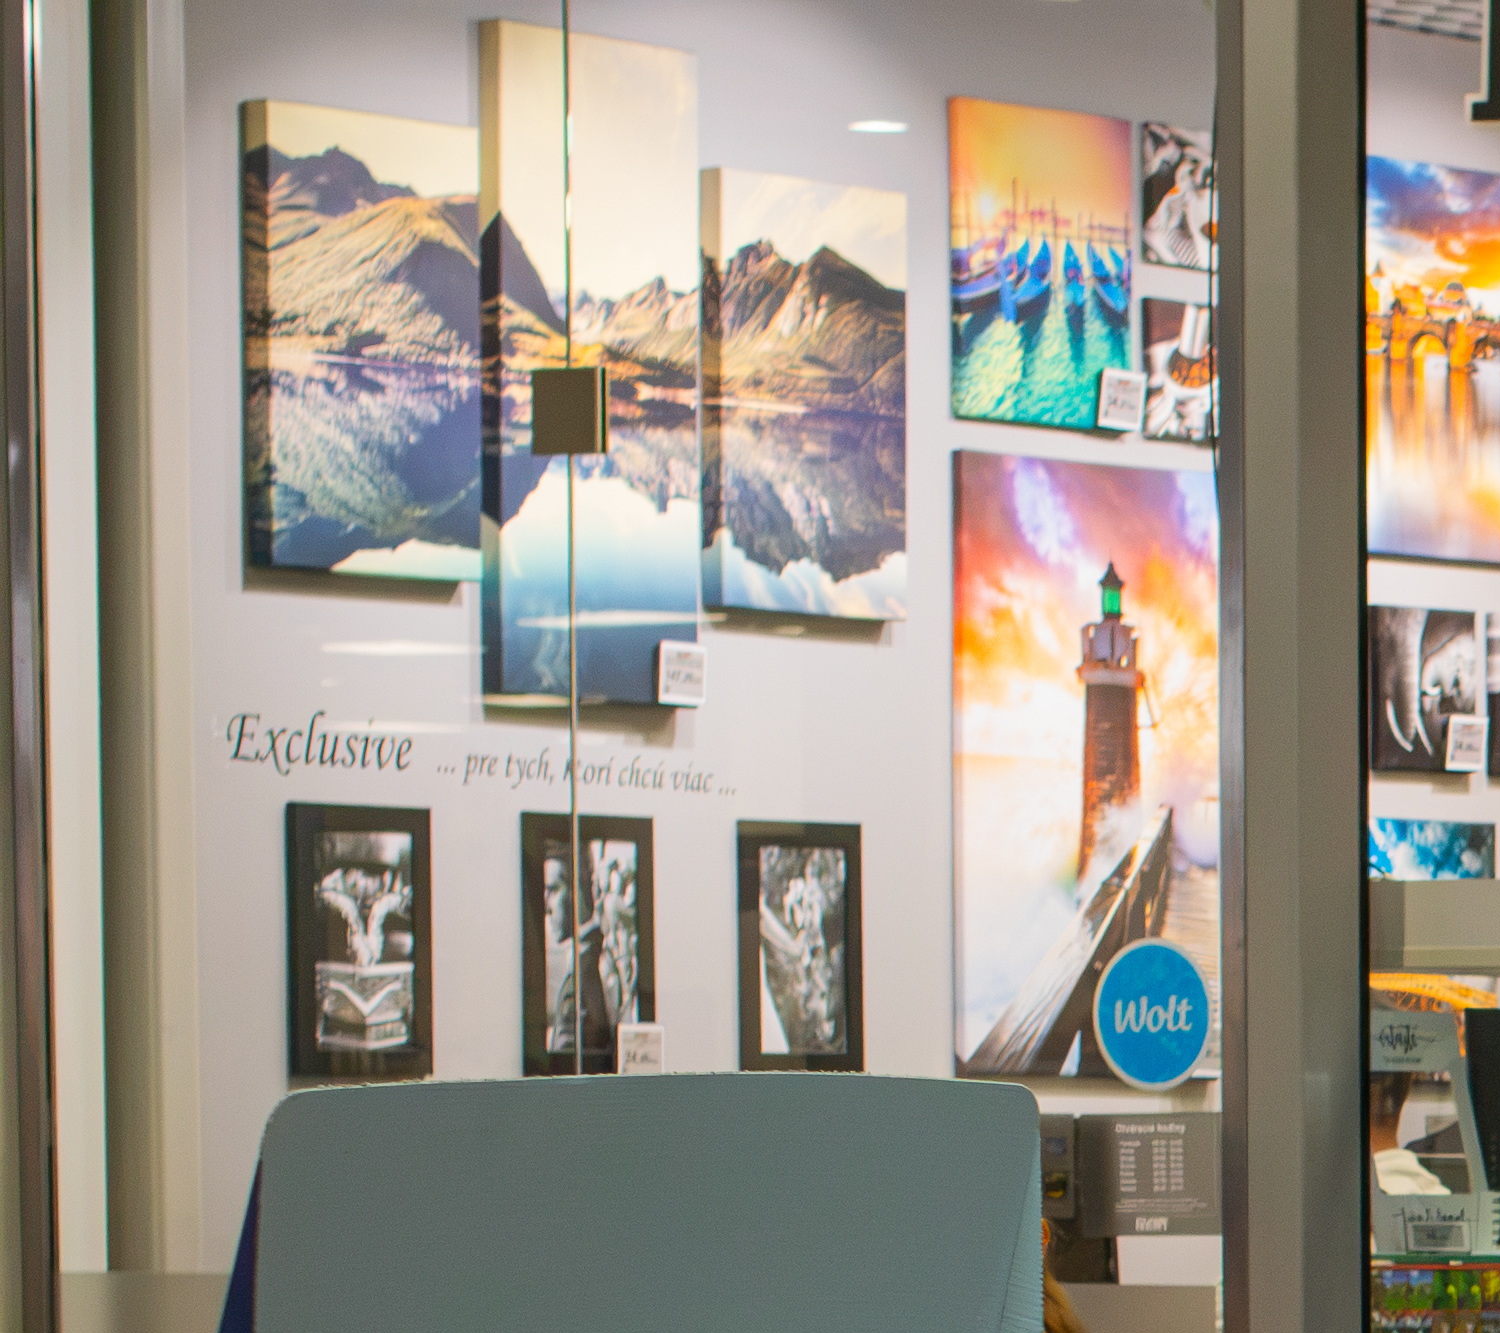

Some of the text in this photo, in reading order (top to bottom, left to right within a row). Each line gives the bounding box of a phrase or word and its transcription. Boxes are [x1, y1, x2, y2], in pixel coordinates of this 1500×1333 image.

[227, 712, 413, 776] Exclusive
[463, 752, 498, 786] pre
[505, 748, 555, 788] tych,
[617, 754, 664, 790] chcú
[670, 764, 714, 794] viac
[1113, 995, 1194, 1034] Wolt
